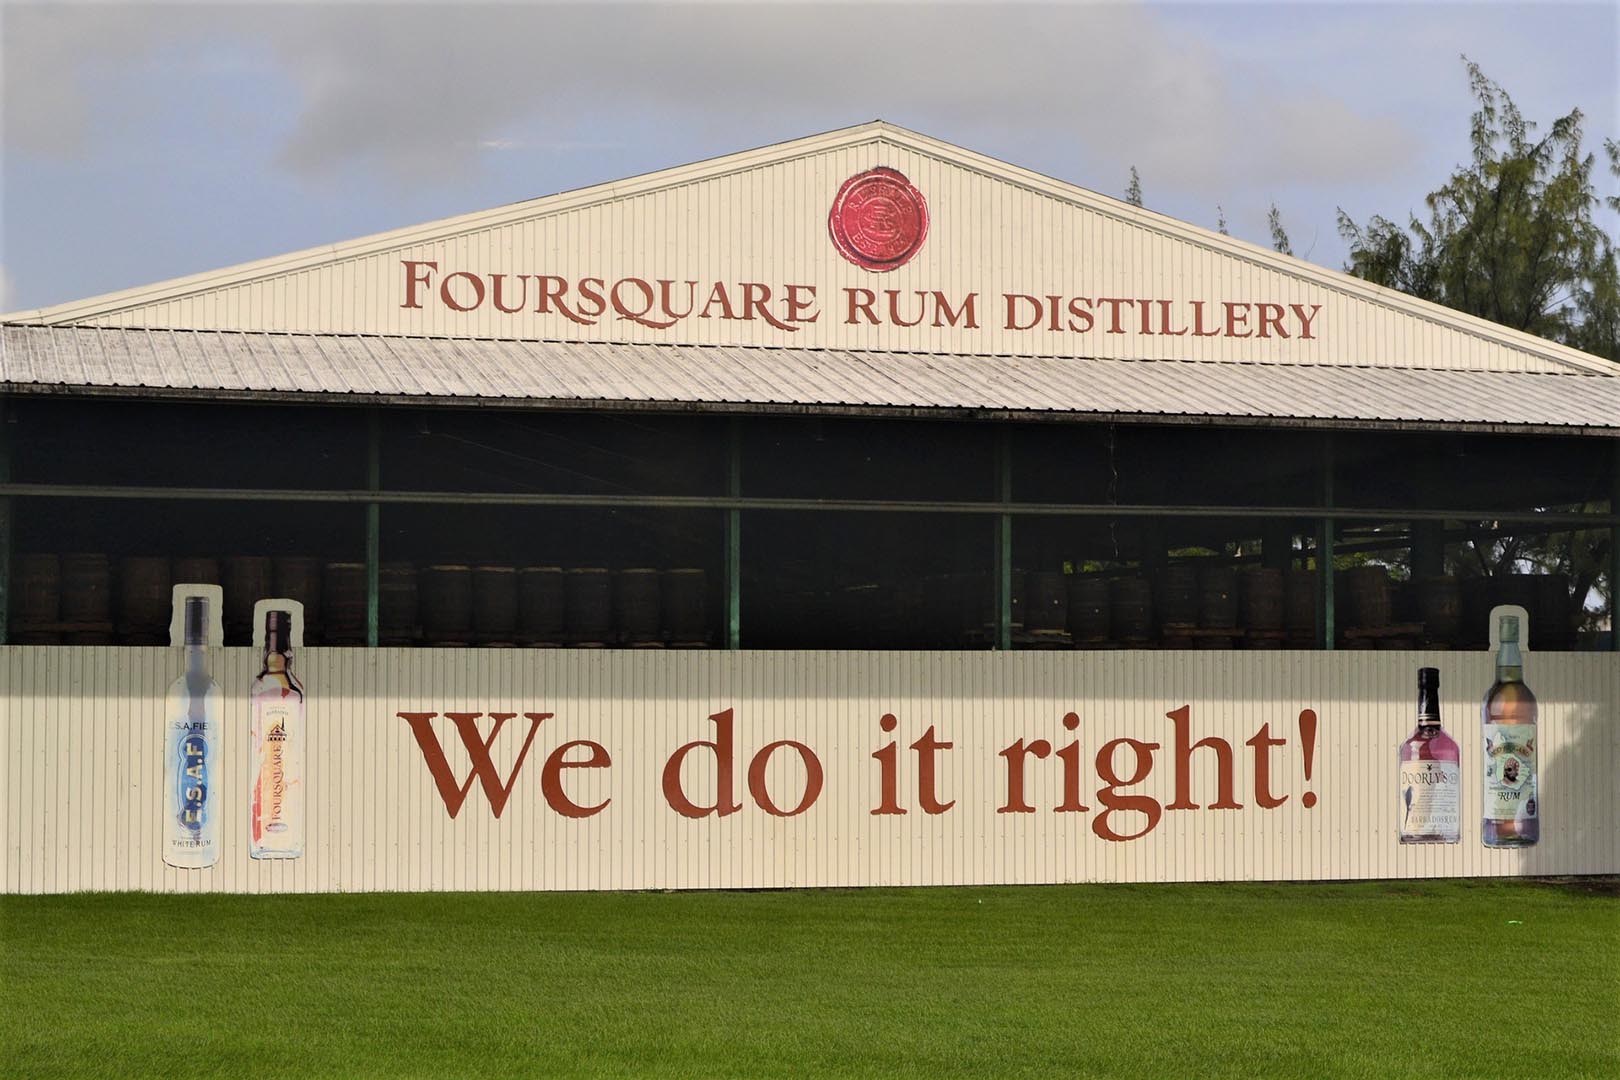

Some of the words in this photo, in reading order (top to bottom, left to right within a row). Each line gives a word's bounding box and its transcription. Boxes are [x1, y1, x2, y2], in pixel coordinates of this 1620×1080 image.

[400, 260, 821, 332] FOURSQUARE
[843, 287, 980, 329] RUM
[1003, 293, 1323, 339] DISTILLERY
[396, 712, 612, 819] We
[662, 707, 824, 819] do
[870, 713, 956, 815] it
[997, 704, 1319, 842] right!
[1498, 791, 1521, 802] RUM
